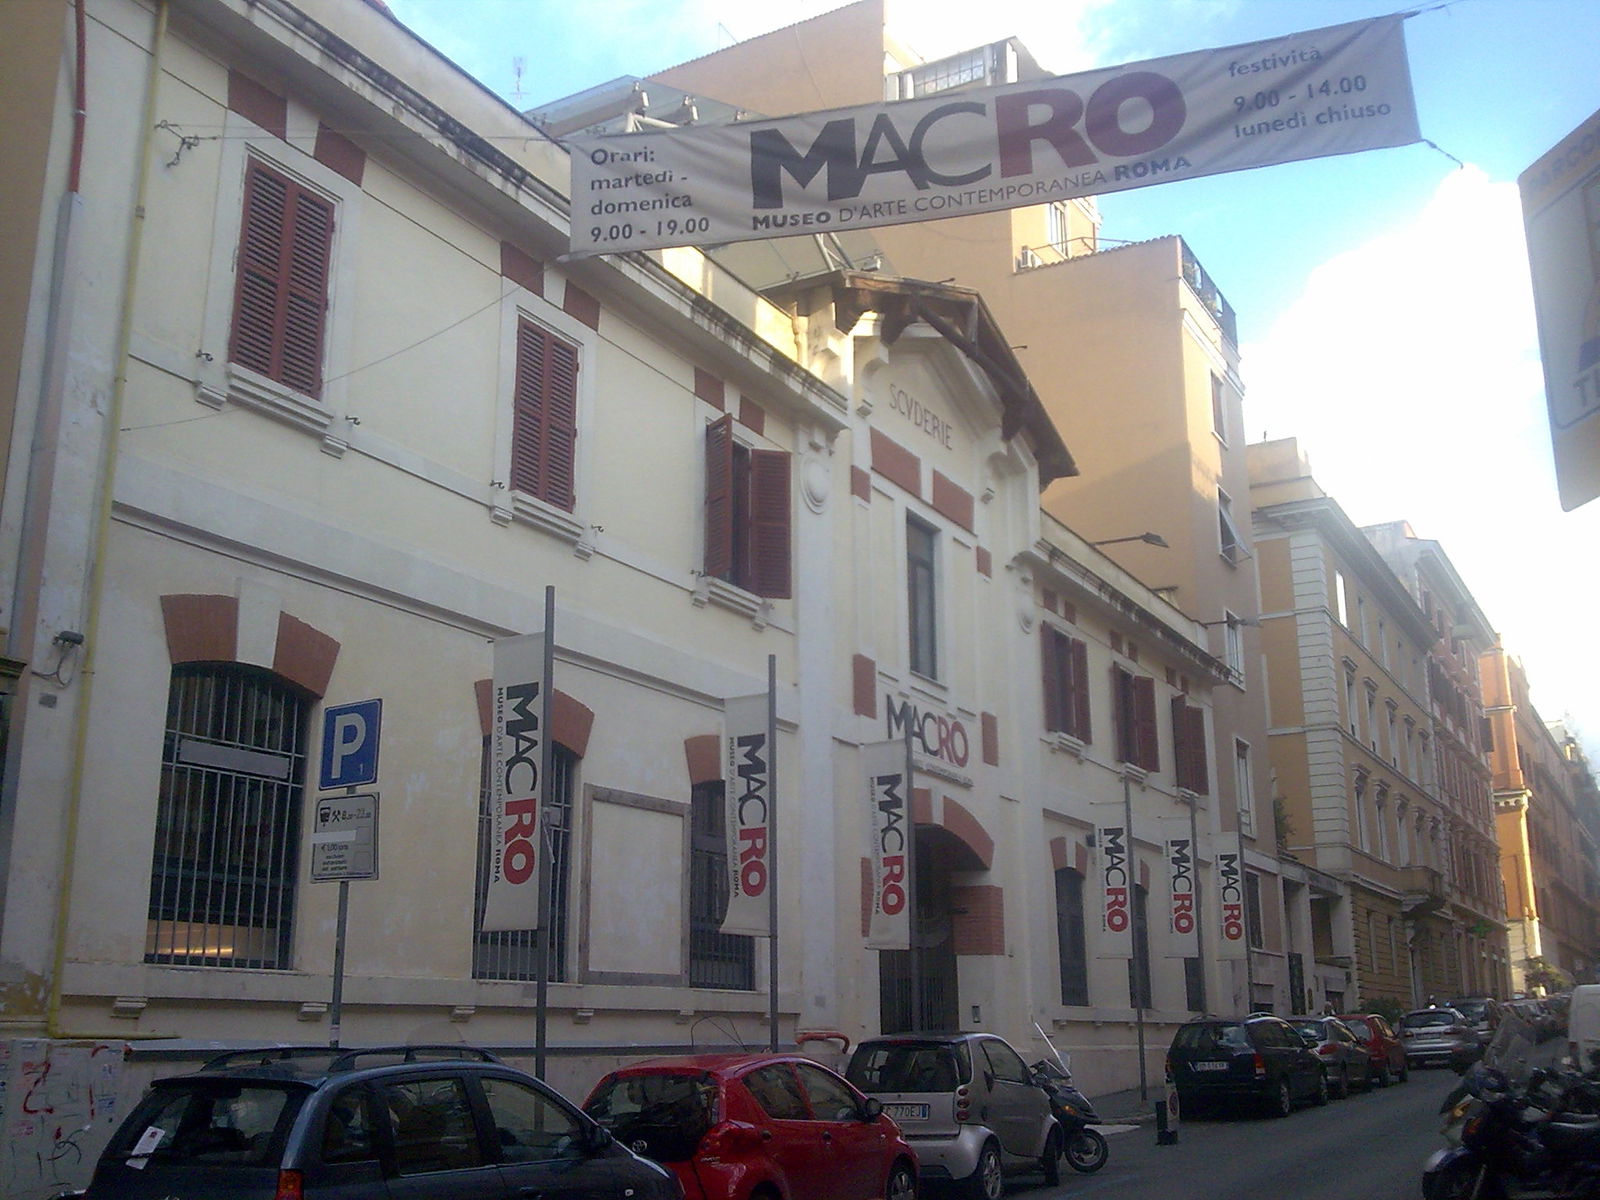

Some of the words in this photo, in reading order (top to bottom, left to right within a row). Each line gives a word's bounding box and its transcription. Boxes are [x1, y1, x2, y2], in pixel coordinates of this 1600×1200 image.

[1229, 46, 1322, 77] festività
[1233, 89, 1280, 113] 9.00
[1307, 75, 1367, 99] 14.00
[750, 70, 1187, 210] MACRO
[1315, 103, 1391, 126] chiuso
[590, 146, 655, 166] Orari:
[591, 194, 693, 215] domenica
[591, 223, 633, 242] 9.00
[657, 216, 709, 236] 19.00
[752, 211, 831, 231] MUSEO
[839, 200, 907, 223] D'ARTE
[913, 170, 1107, 212] CONTEMPORANEA
[1113, 156, 1192, 182] ROMA
[496, 687, 504, 723] MUSEO
[886, 693, 970, 769] MACRO
[331, 712, 367, 779] P
[503, 682, 539, 885] MACRO
[737, 733, 768, 897] MACRO
[493, 848, 502, 883] ROMA
[876, 773, 906, 916] MACRO
[1103, 827, 1129, 933] MACRO
[1170, 839, 1195, 934] MACRO
[1219, 853, 1243, 941] MACRO
